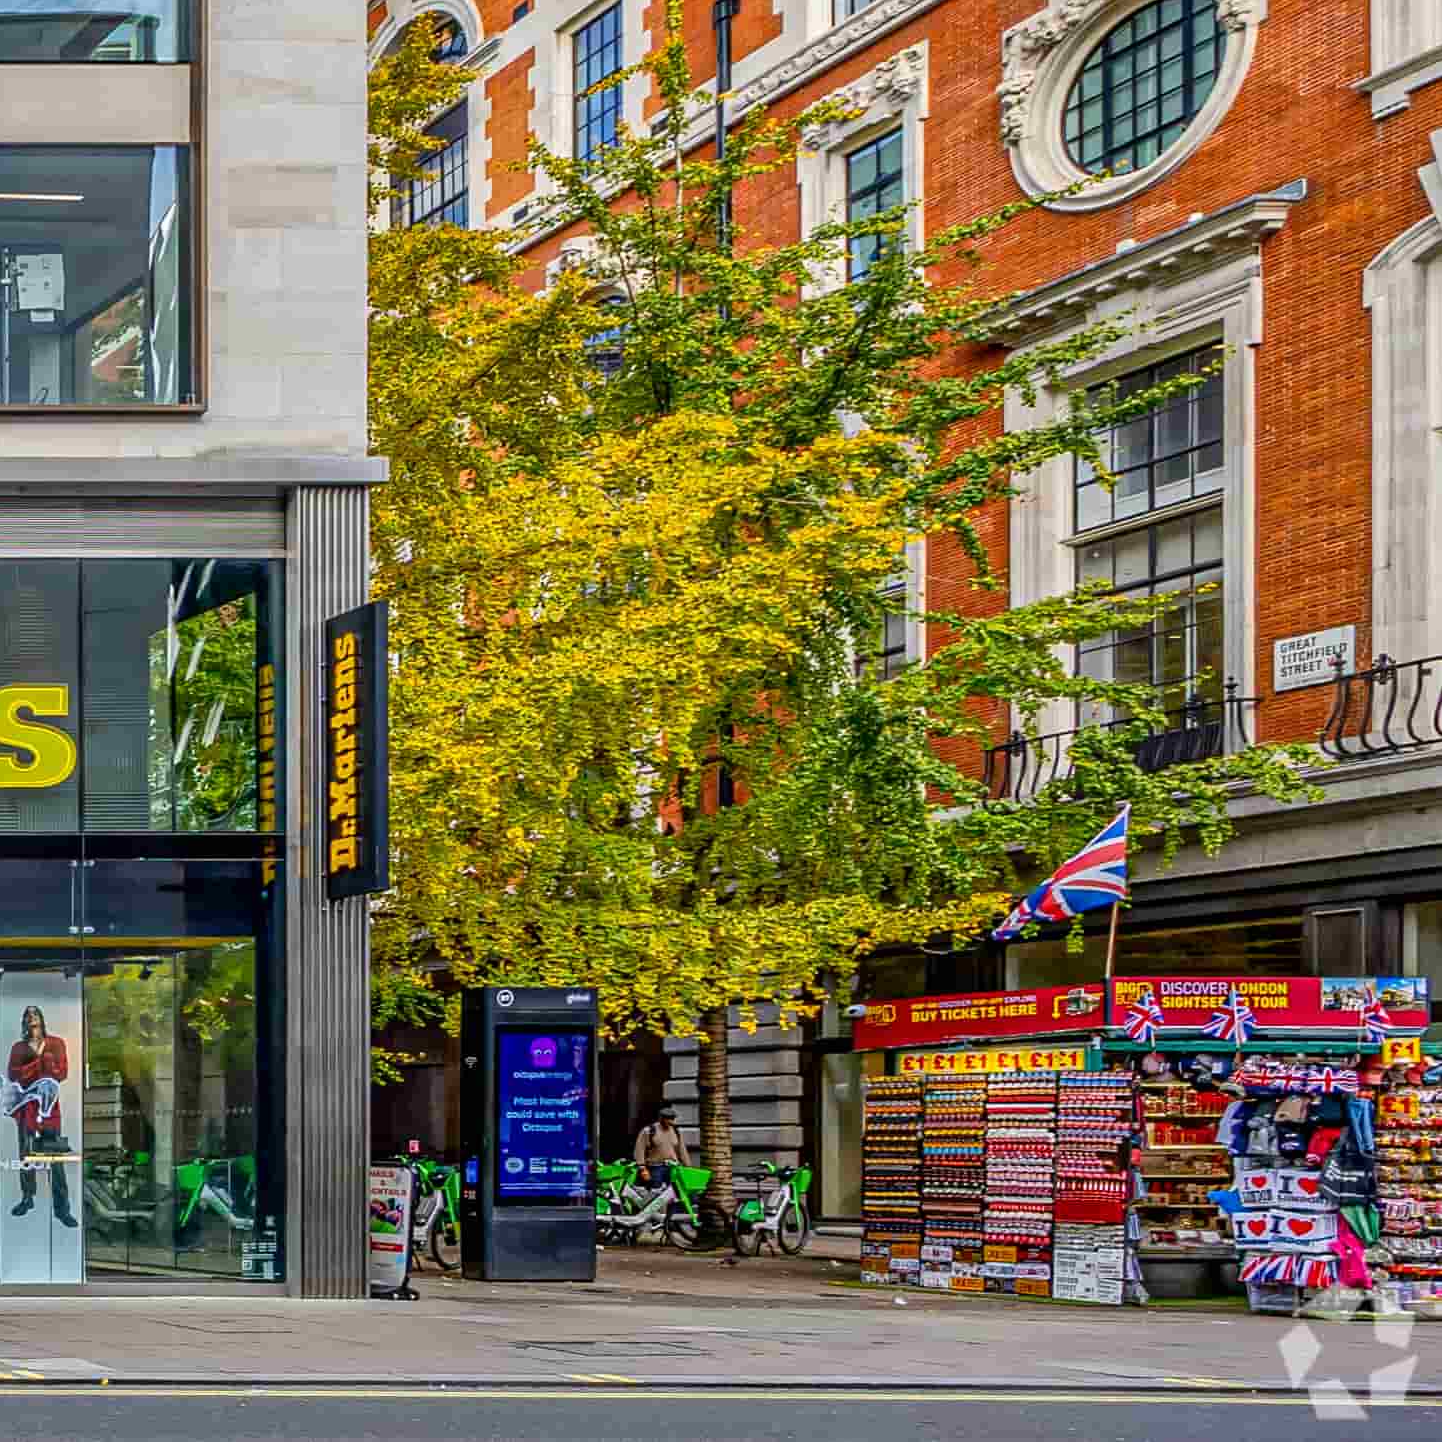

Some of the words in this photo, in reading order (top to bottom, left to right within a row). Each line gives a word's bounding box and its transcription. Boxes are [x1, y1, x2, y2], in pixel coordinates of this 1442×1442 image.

[1280, 637, 1318, 653] GREAT
[1280, 642, 1348, 663] TITCHFIELD
[1280, 660, 1323, 677] STREET
[1160, 981, 1229, 996] DISCOVER
[1251, 996, 1289, 1008] TOUR
[911, 1009, 939, 1023] BUY
[939, 1004, 997, 1021] TICKETS
[999, 1003, 1037, 1018] HERE
[1389, 1040, 1416, 1056] £1
[903, 1055, 924, 1071] £1
[932, 1053, 955, 1070] £1
[965, 1052, 988, 1069] £1
[997, 1052, 1021, 1069] £1
[1030, 1051, 1054, 1068] £1
